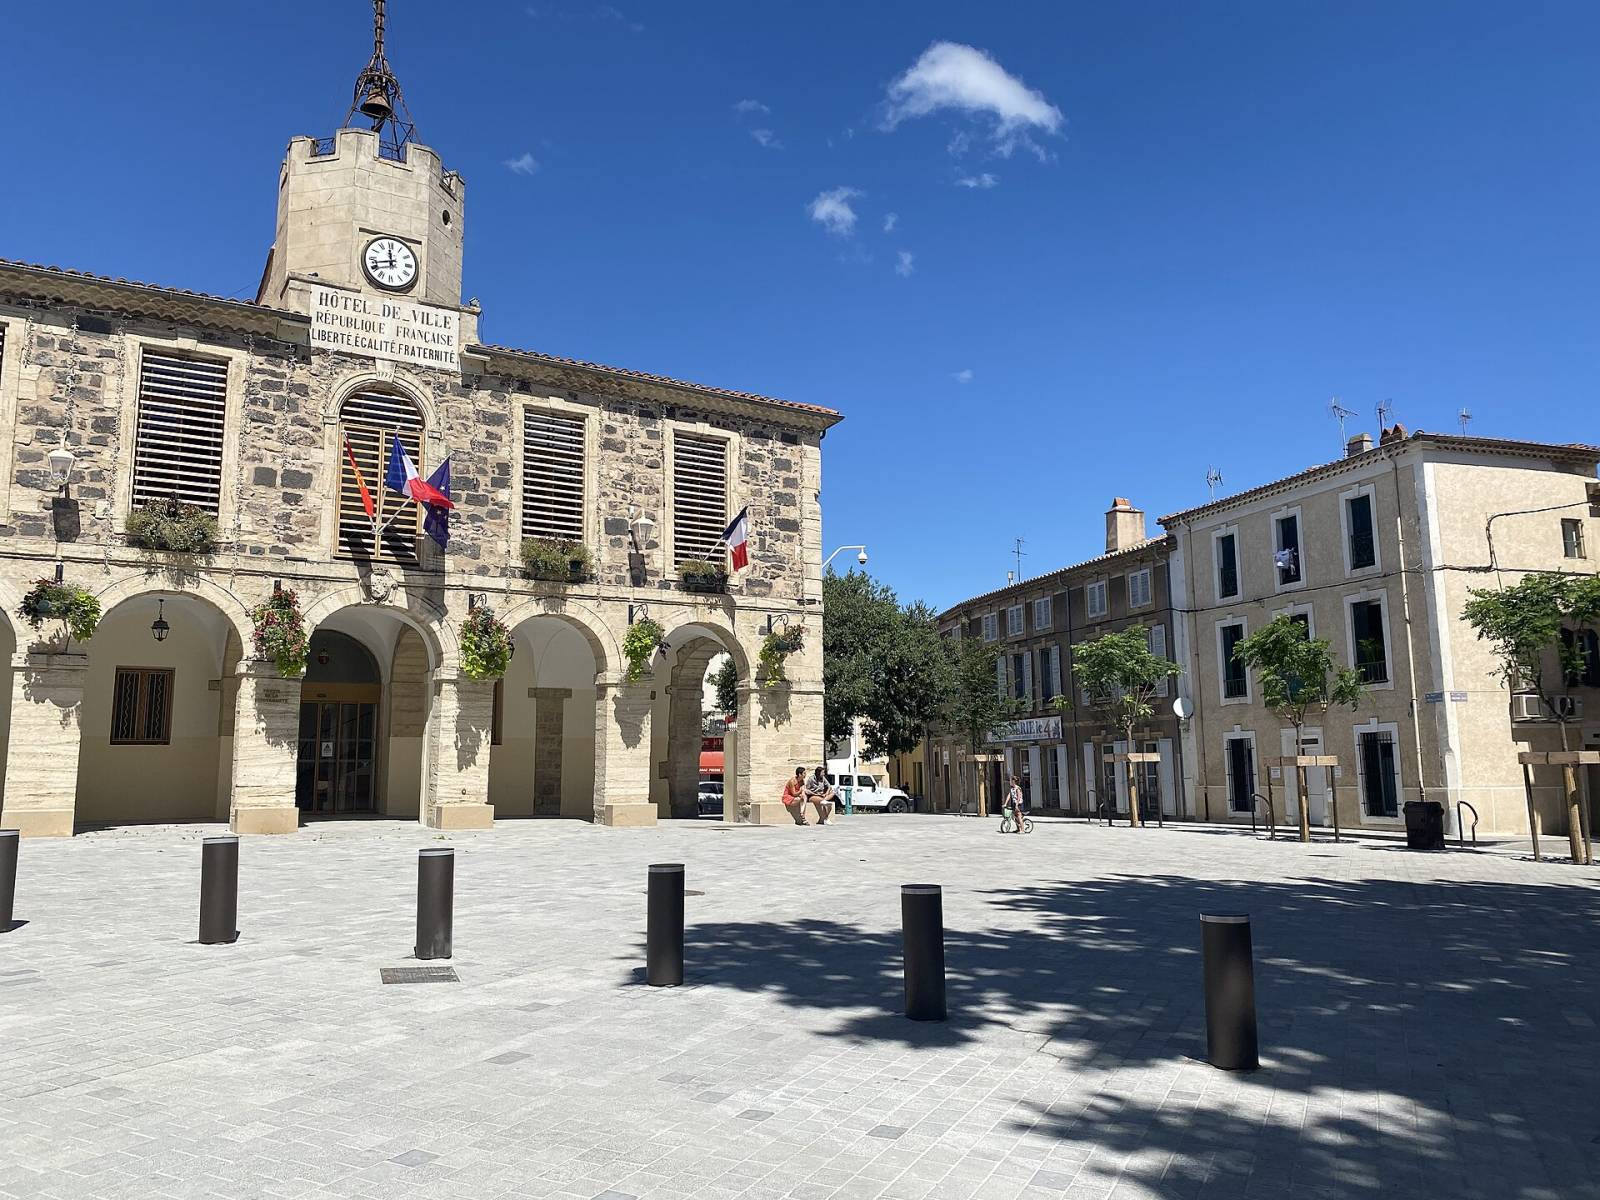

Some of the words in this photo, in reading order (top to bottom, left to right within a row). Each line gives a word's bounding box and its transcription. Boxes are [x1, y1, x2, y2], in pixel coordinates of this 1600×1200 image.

[319, 290, 371, 314] HÔTEL
[382, 304, 401, 320] DE
[412, 309, 452, 330] VILLE
[316, 309, 386, 335] RÉPUBLIQUE
[396, 326, 454, 347] FRANÇAISE
[398, 343, 456, 364] FRATERNITÉ
[1044, 719, 1051, 738] 4
